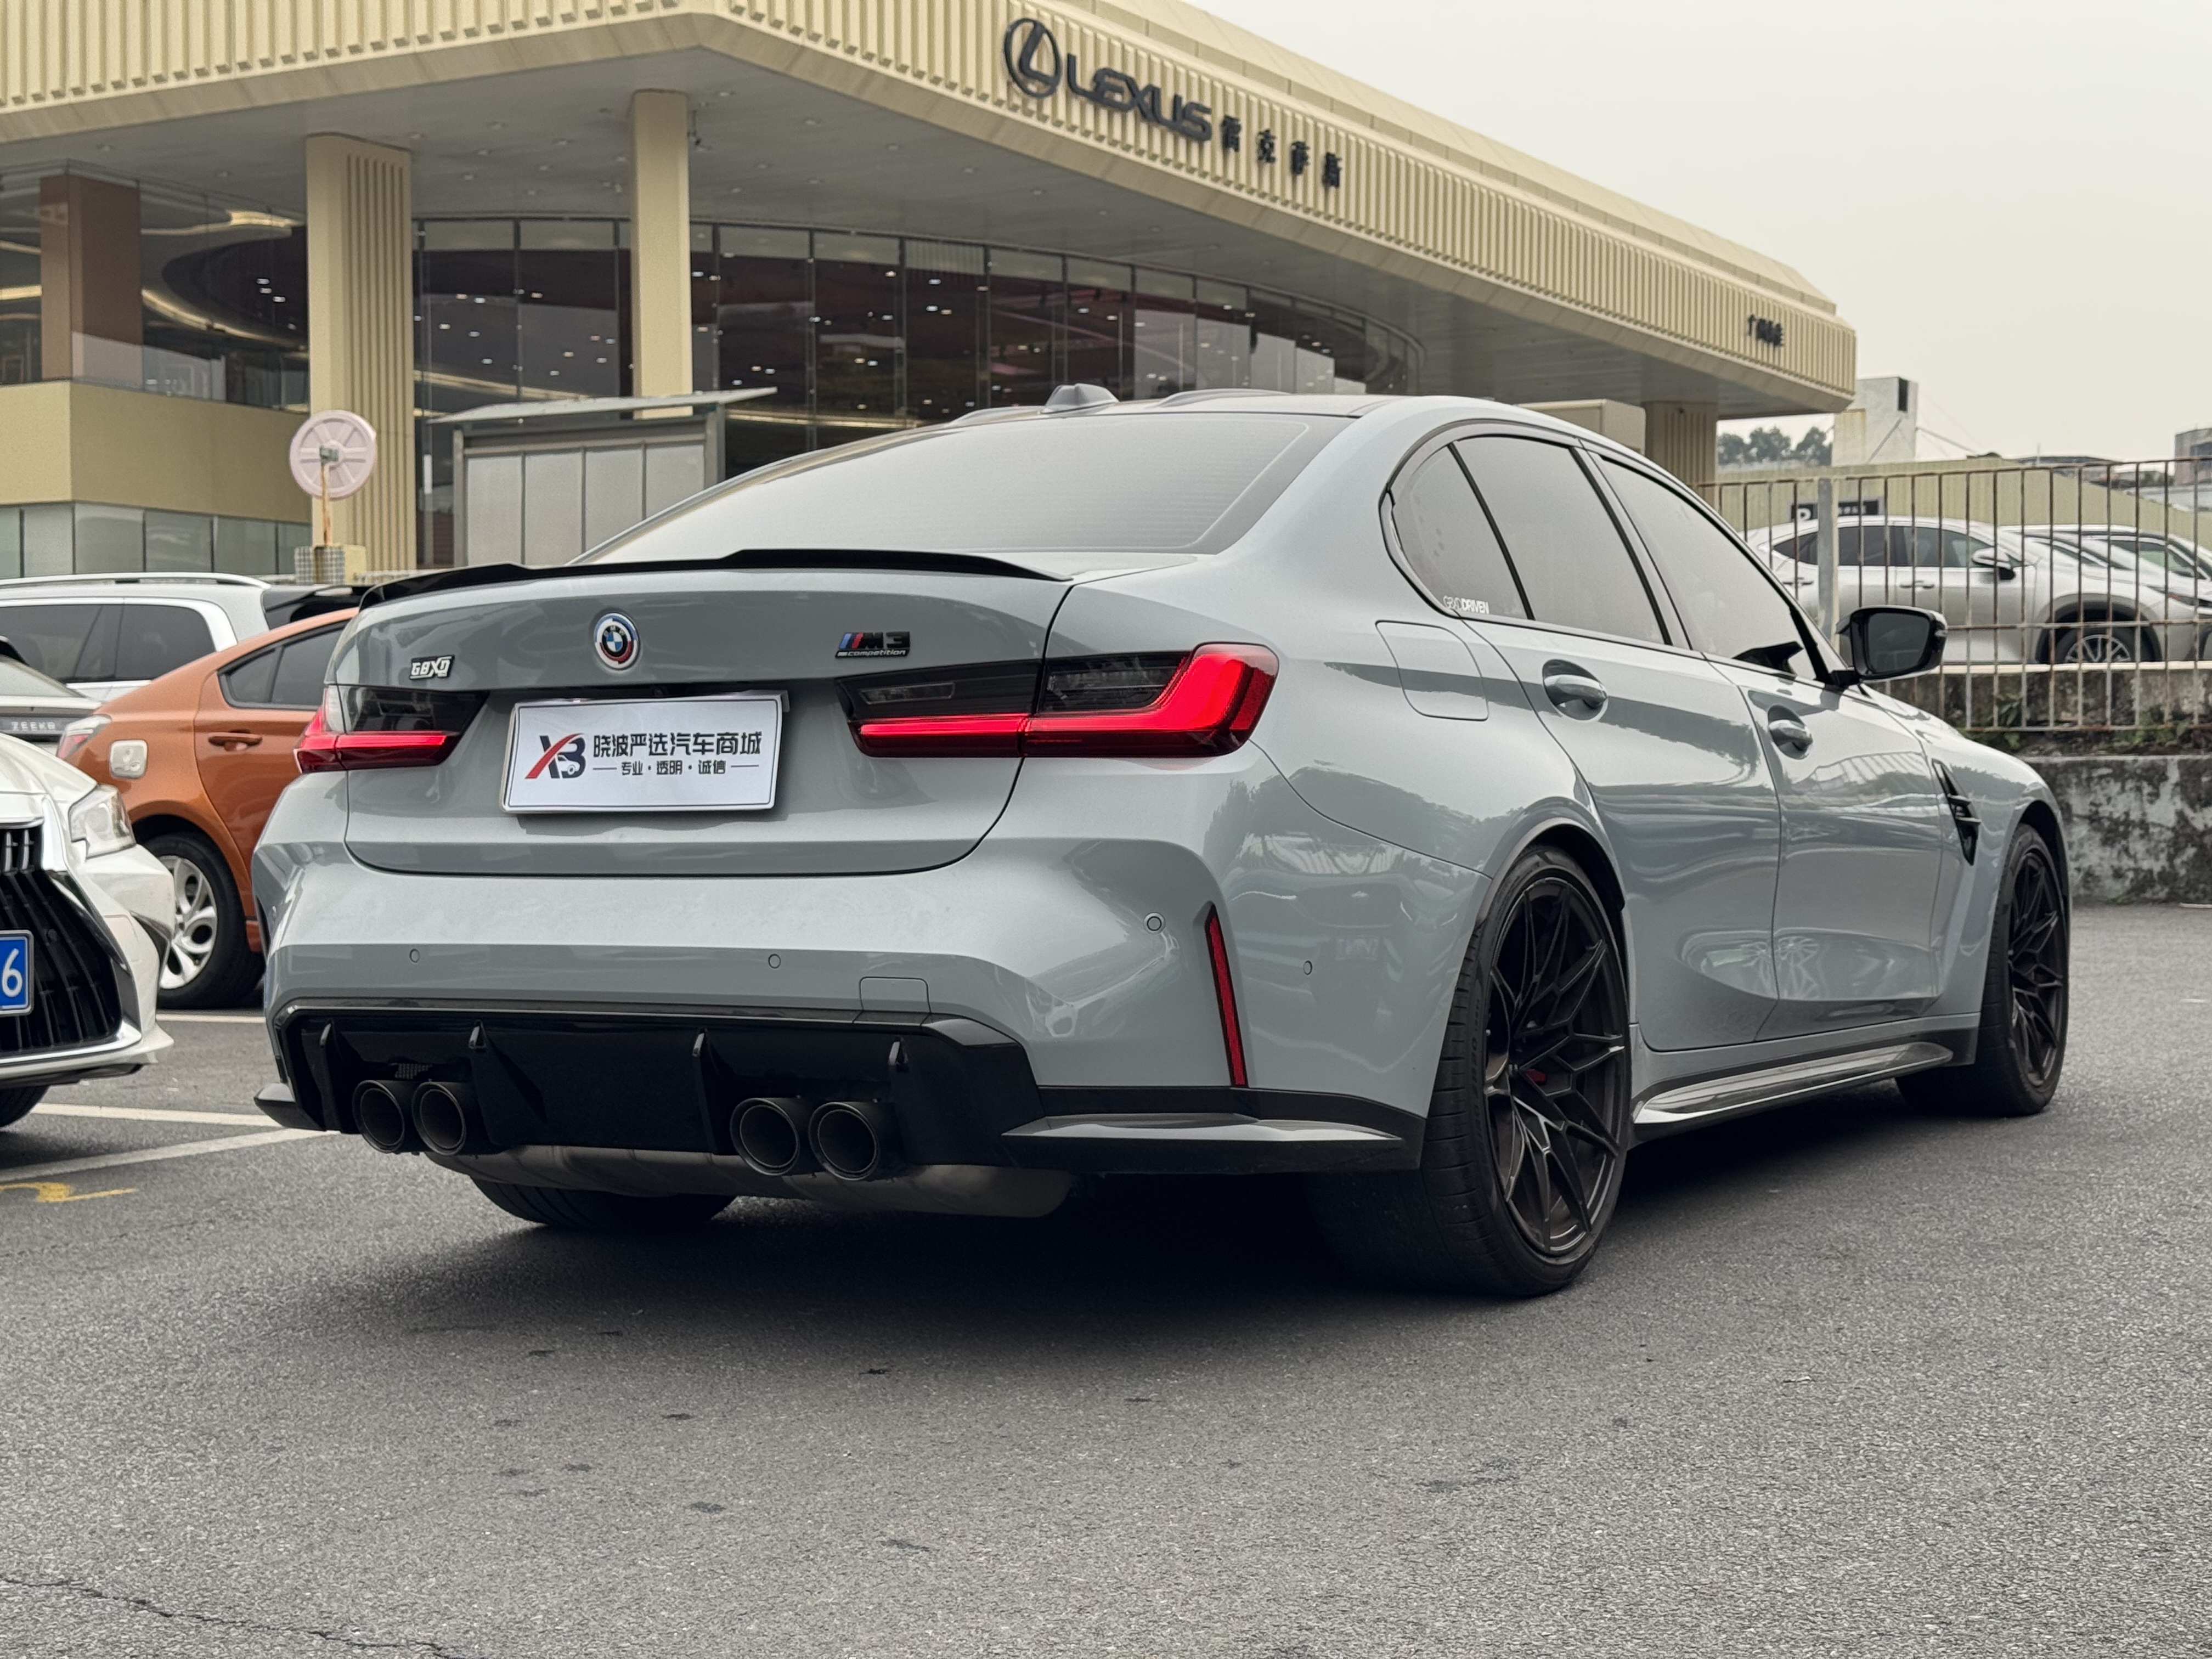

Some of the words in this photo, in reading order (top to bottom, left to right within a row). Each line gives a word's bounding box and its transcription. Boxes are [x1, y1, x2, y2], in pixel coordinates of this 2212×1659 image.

[1066, 53, 1212, 142] LEXUS
[593, 730, 763, 757] 晓波严选汽车商城
[2, 947, 23, 998] 6
